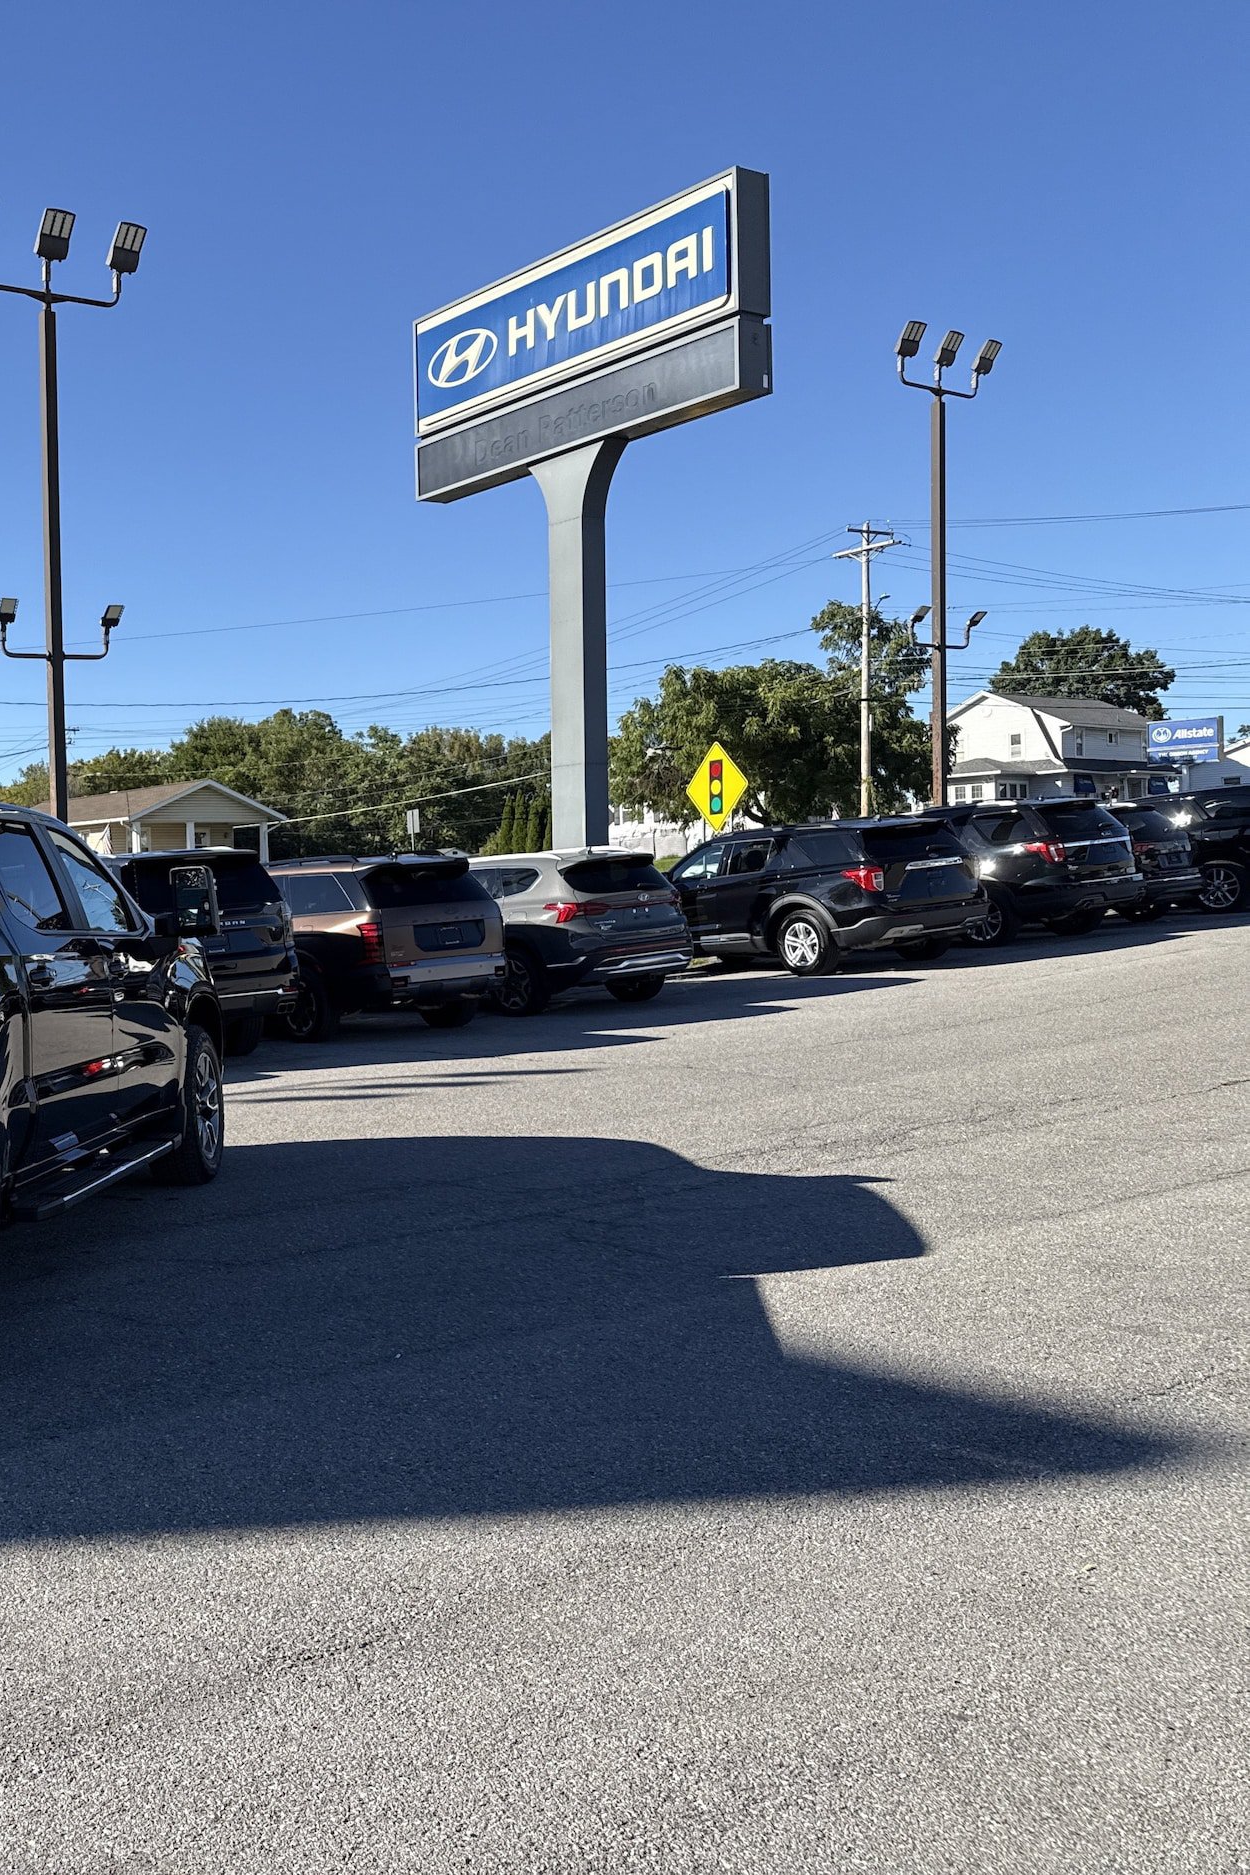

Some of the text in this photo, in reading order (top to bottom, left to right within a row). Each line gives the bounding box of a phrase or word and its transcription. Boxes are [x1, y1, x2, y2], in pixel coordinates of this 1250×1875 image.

[508, 225, 714, 357] HYUNDAI
[475, 381, 657, 466] Dean Patterson
[1172, 727, 1215, 740] Allstate
